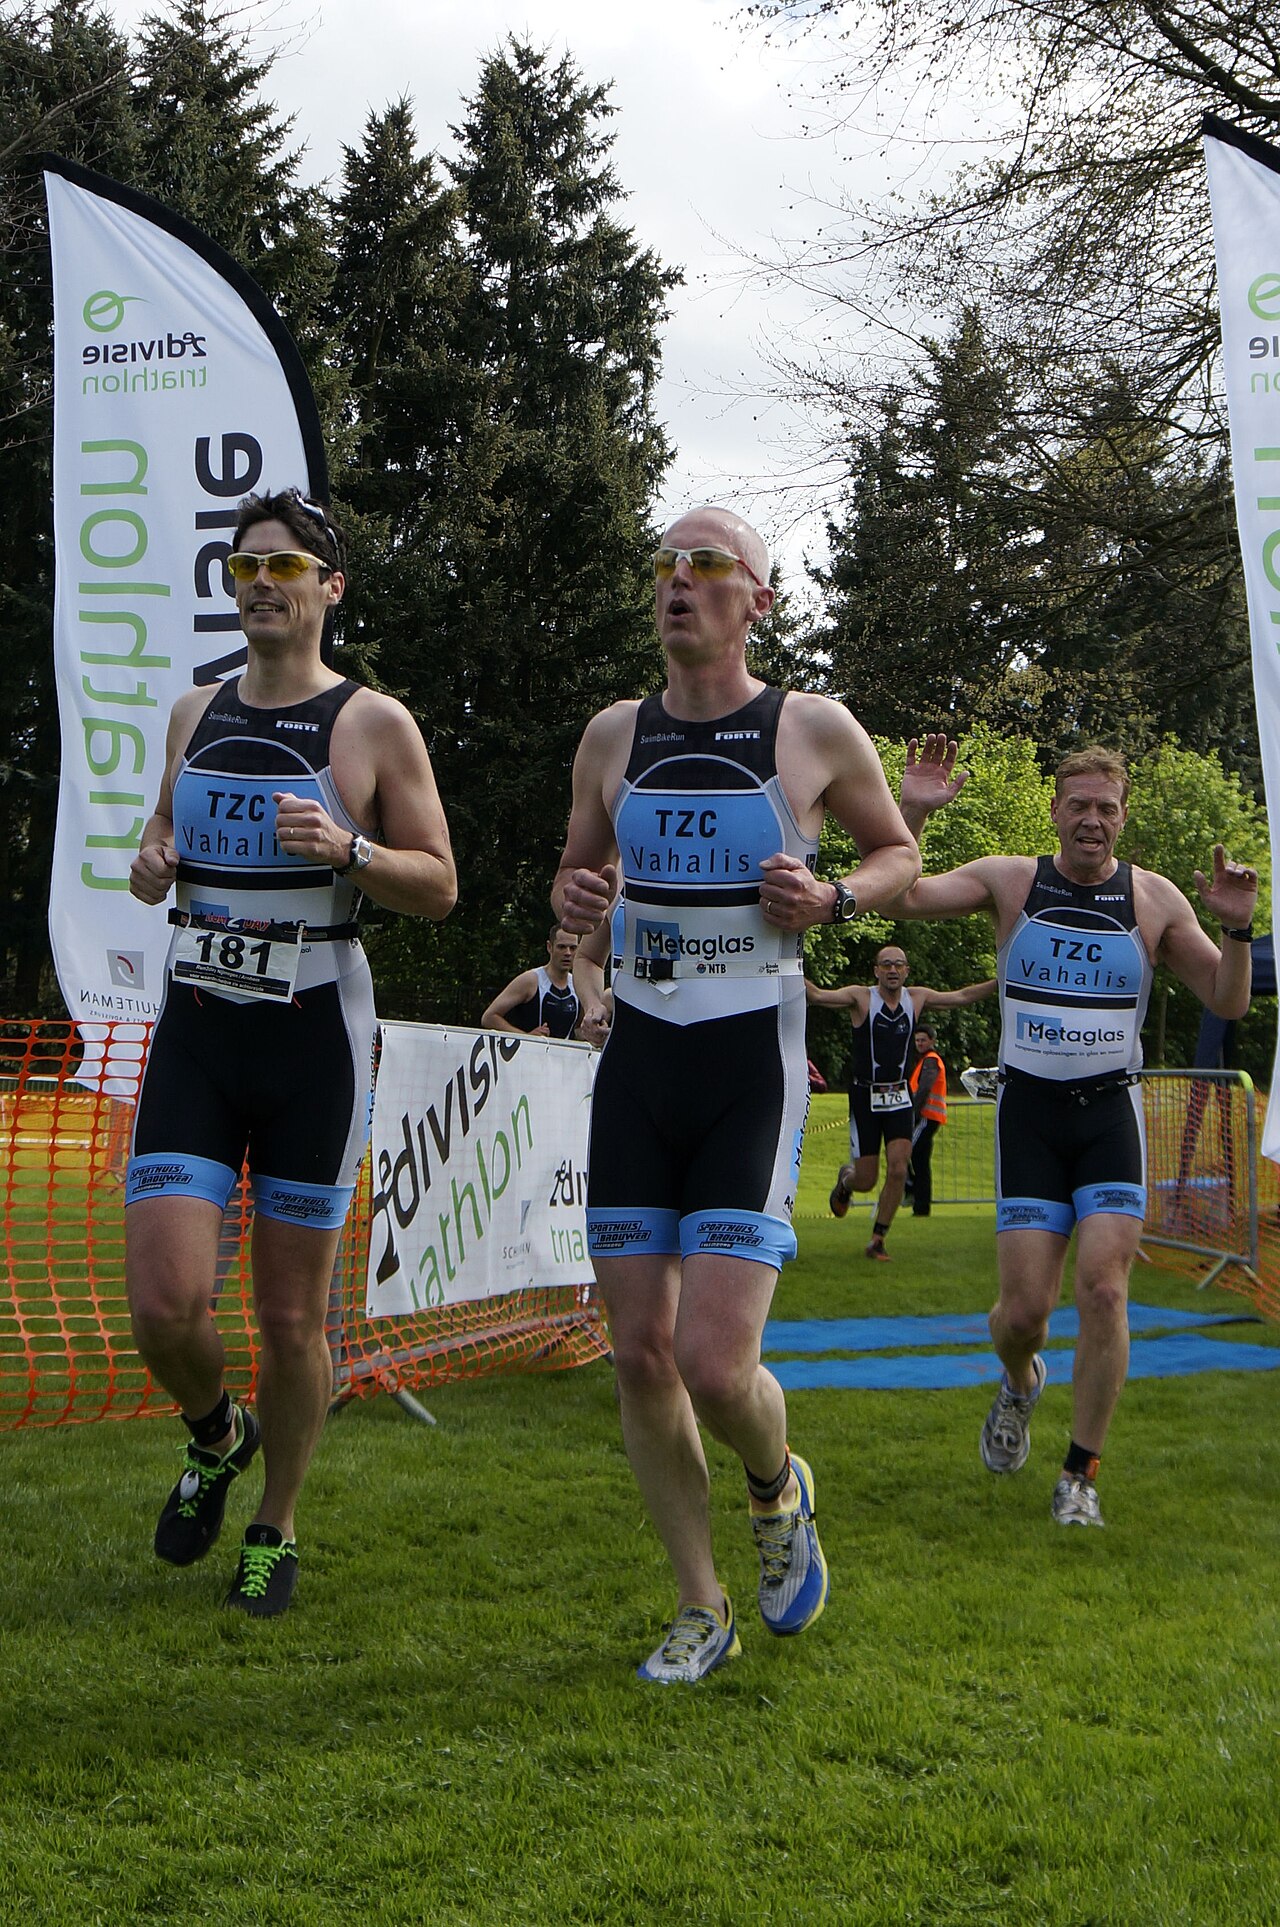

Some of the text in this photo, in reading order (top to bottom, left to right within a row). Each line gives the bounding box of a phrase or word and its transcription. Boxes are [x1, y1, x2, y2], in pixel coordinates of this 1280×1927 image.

[276, 720, 320, 732] FORTE
[640, 732, 685, 744] SwimBikeRun
[715, 730, 761, 741] FORTE
[207, 790, 265, 822] TZC
[655, 809, 717, 838] TZC
[630, 846, 750, 874] Vahalis
[196, 931, 272, 976] 181
[647, 928, 755, 961] Metaglas
[1050, 937, 1102, 963] TZC
[708, 963, 727, 974] NTB
[1020, 958, 1127, 988] Vahalis
[1027, 1019, 1125, 1047] Metaglas
[600, 1232, 649, 1242] BROUWER
[699, 1223, 755, 1234] SPORTHUIS
[709, 1233, 762, 1245] BROUWER
